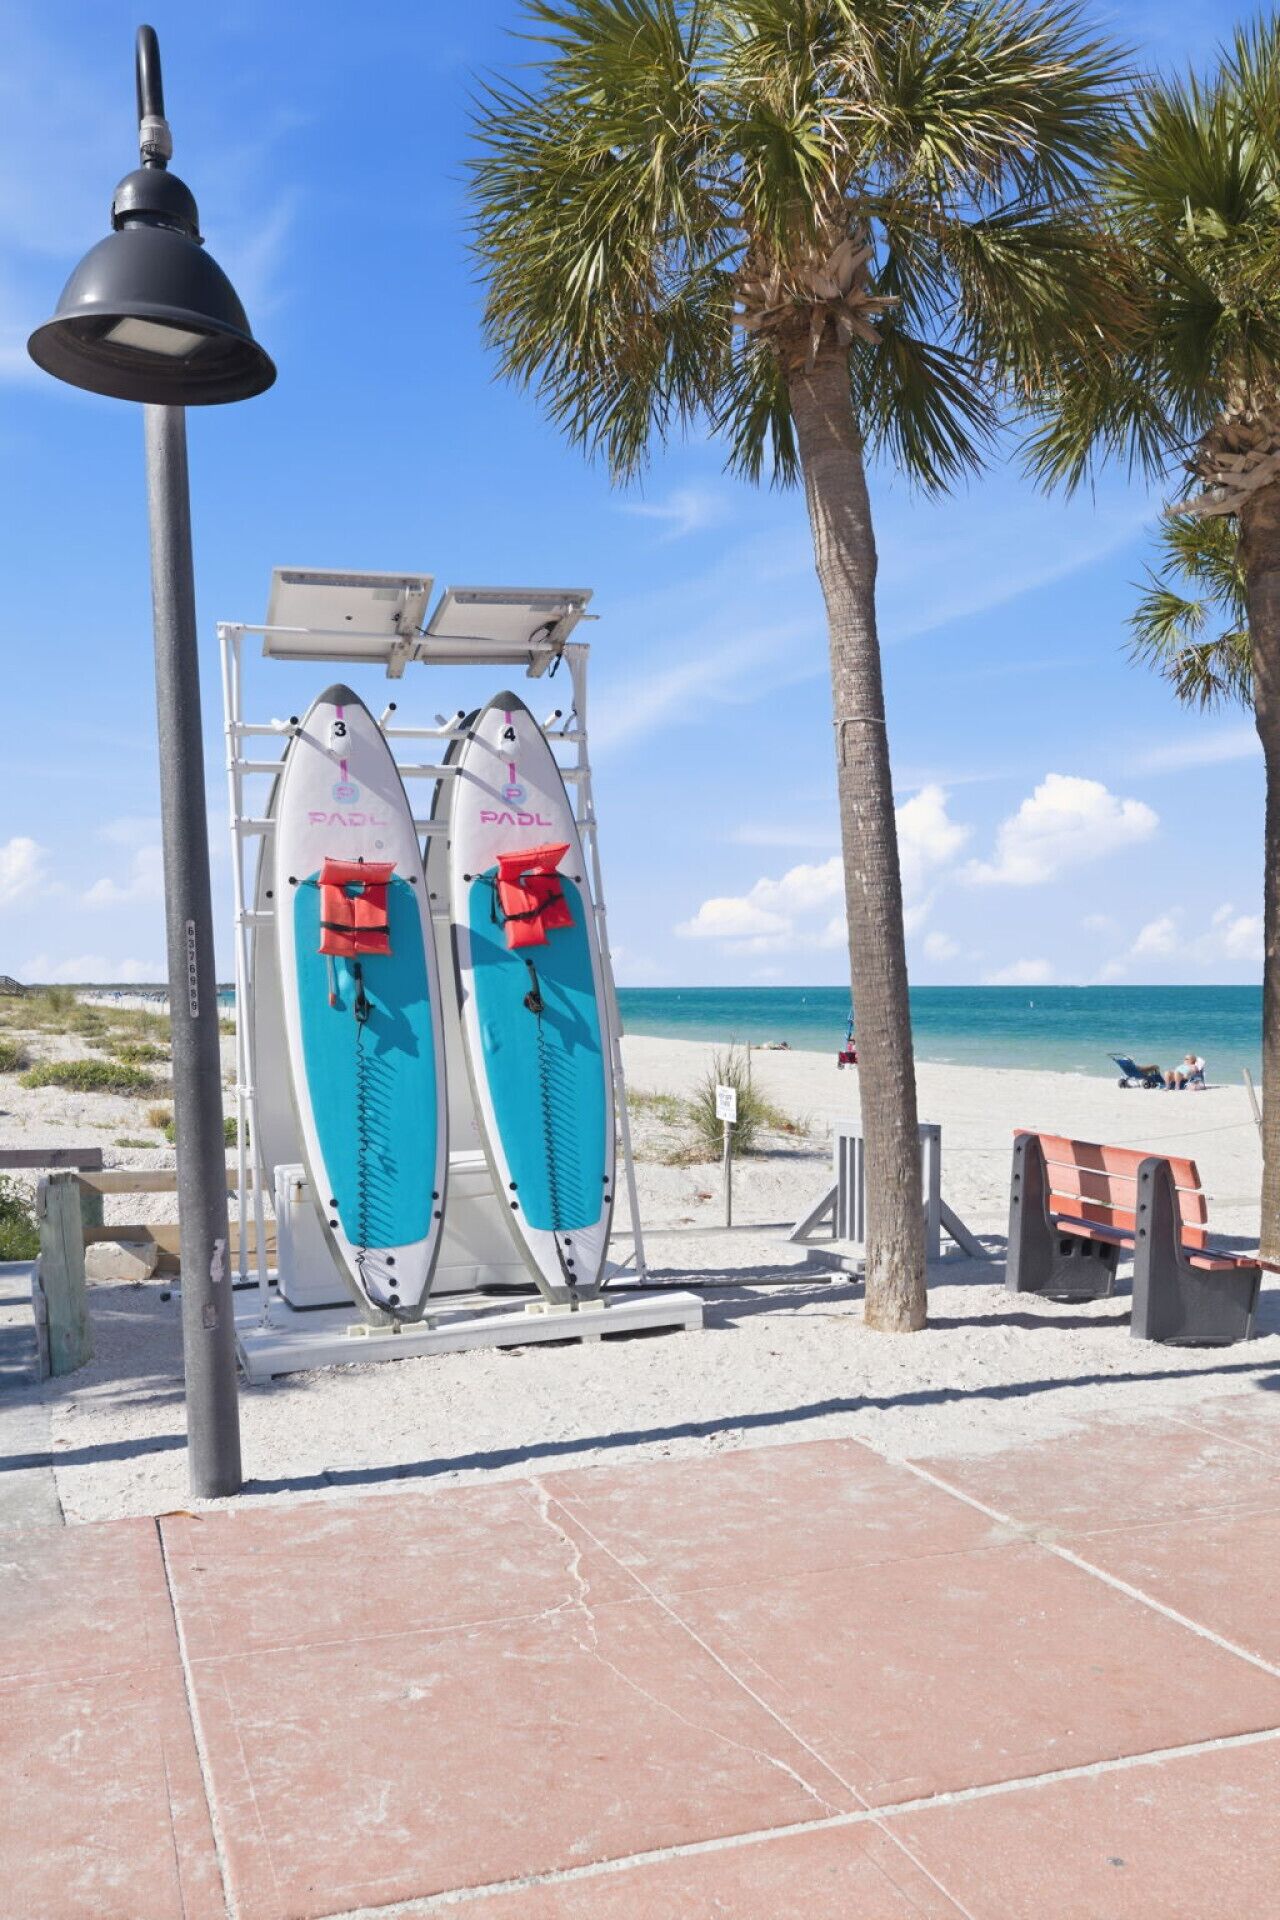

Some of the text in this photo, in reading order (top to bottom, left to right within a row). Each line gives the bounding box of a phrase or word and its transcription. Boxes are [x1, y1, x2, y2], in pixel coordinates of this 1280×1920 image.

[334, 721, 347, 737] 3
[504, 727, 516, 742] 4
[506, 788, 522, 801] P
[308, 811, 388, 827] PADL
[480, 810, 553, 827] PADL
